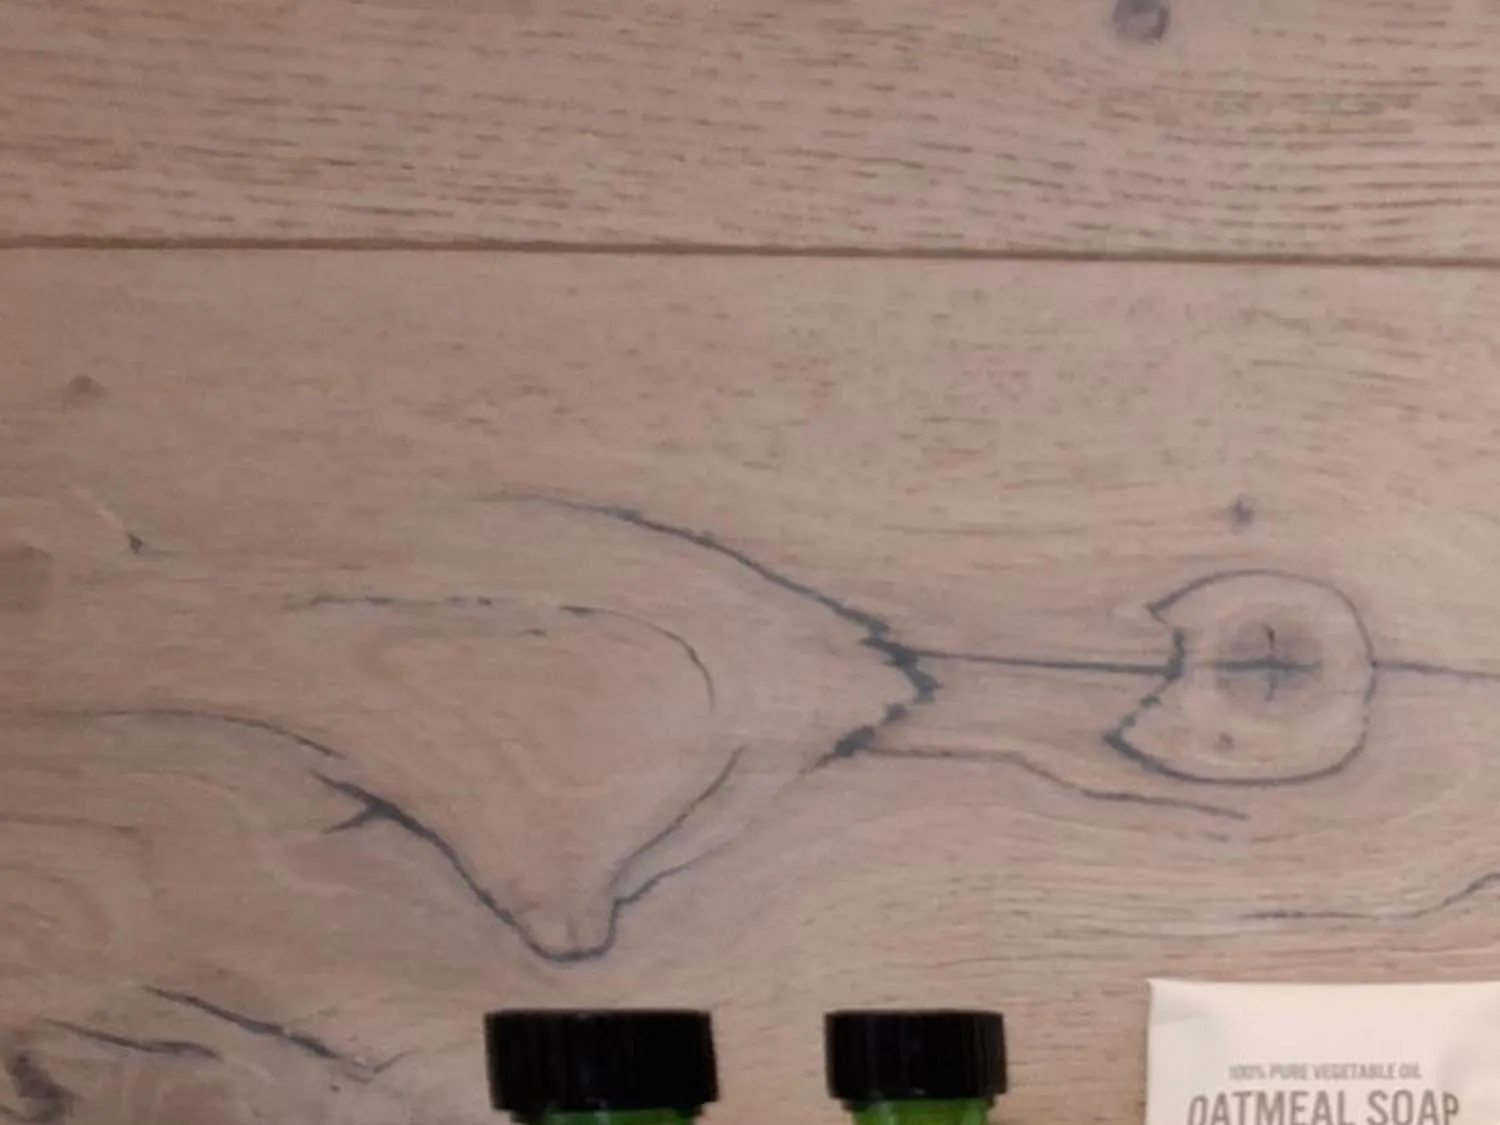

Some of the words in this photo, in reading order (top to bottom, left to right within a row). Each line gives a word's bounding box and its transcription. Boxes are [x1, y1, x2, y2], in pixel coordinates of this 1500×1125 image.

[1228, 1064, 1266, 1082] 100%
[1269, 1063, 1307, 1081] PURE
[1312, 1062, 1397, 1081] VEGETABLE
[1398, 1062, 1423, 1080] OIL
